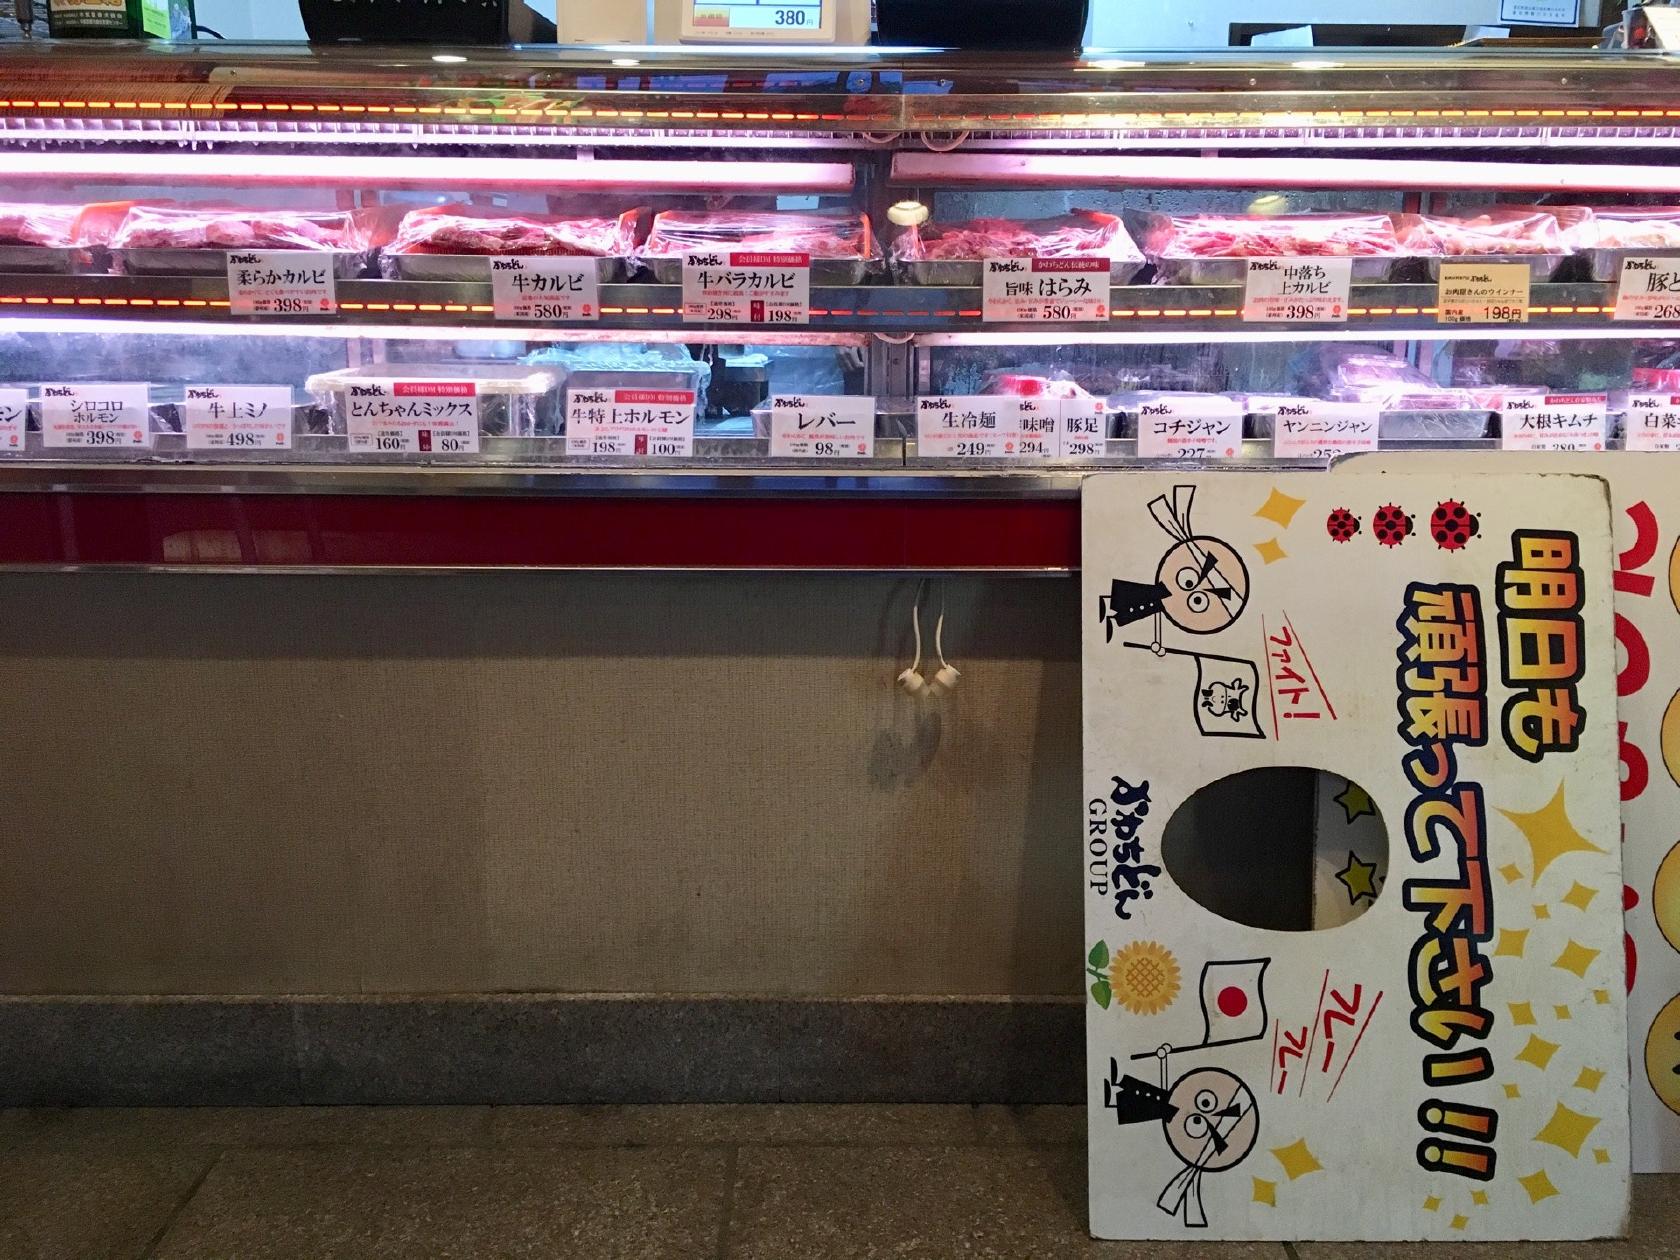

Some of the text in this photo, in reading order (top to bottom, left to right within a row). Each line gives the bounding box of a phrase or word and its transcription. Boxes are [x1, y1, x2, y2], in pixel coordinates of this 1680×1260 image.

[237, 269, 326, 286] 柔らかカルビ
[697, 271, 796, 290] 牛バラカルビ
[1284, 265, 1326, 280] 中落ち
[511, 273, 584, 293] 牛カルビ
[1005, 277, 1092, 297] 旨味 はらみ
[1278, 281, 1332, 295] 上カルビ
[70, 400, 124, 413] シロコロ
[207, 401, 268, 419] 牛上ミノ
[351, 401, 473, 417] とんちゃんミックス
[73, 412, 119, 424] ホルモン
[571, 408, 691, 425] 牛特上ホルモン
[798, 412, 856, 430] レバー
[942, 411, 997, 429] 生冷麺
[1019, 416, 1055, 433] 味噌
[1066, 417, 1098, 433] 豚足
[1520, 413, 1598, 429] 大根キムチ
[1644, 413, 1680, 429] 白菜
[1154, 418, 1231, 436] コチジャン
[1283, 420, 1373, 433] ヤンニンジャン
[1497, 530, 1586, 761] 明日も
[1088, 798, 1108, 896] GROUP
[1110, 776, 1162, 920] かわちどん
[1322, 983, 1362, 1073] フレー
[1278, 1026, 1308, 1095] フレー
